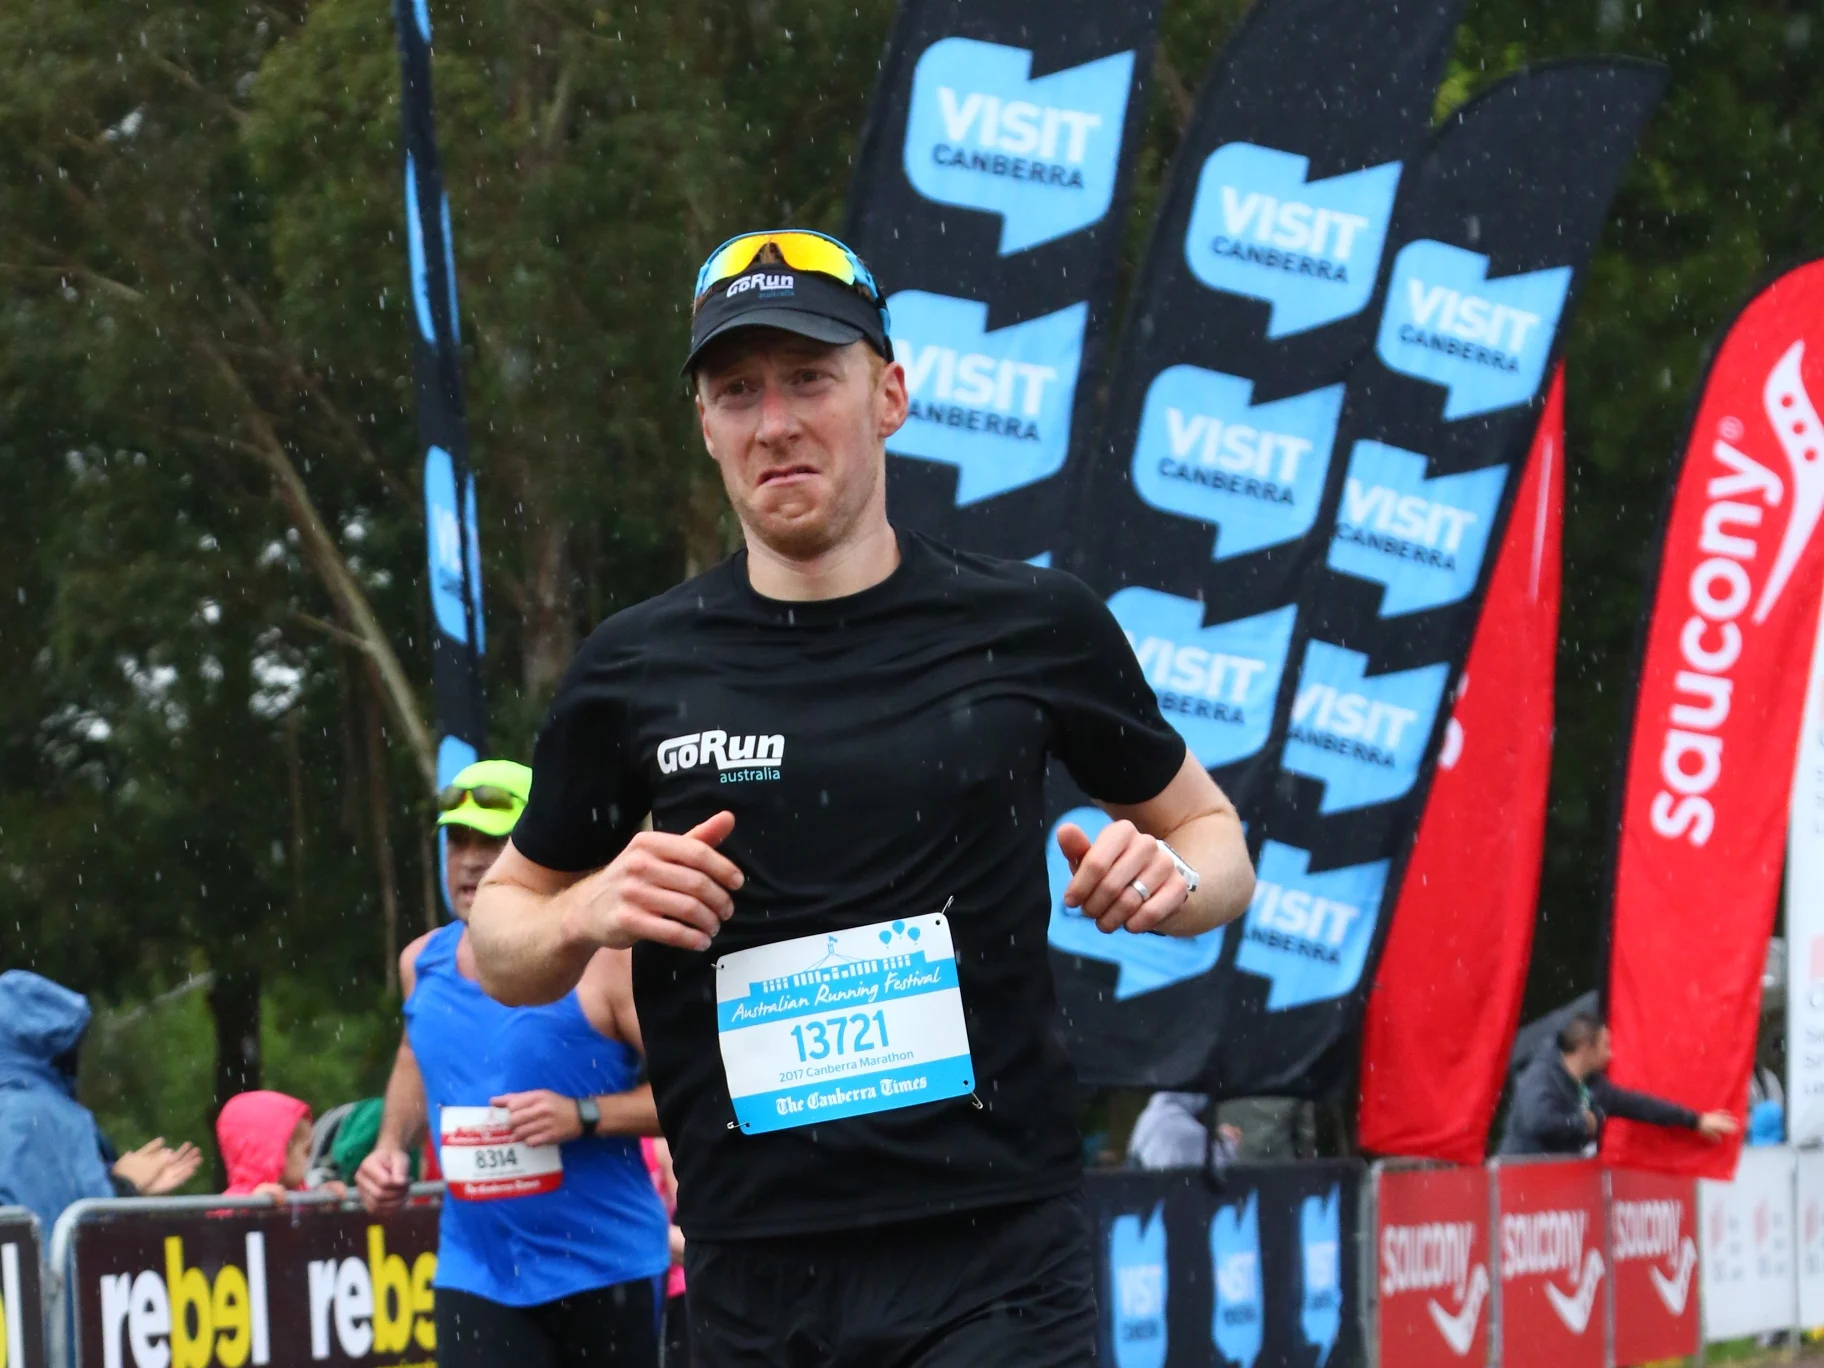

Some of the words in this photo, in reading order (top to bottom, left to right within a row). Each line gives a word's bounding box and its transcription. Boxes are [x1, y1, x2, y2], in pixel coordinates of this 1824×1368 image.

[936, 86, 1102, 162] VISIT
[931, 143, 1084, 189] CANBERRA
[1221, 185, 1369, 260] VISIT
[1211, 235, 1349, 283] CANBERRA
[726, 272, 794, 298] GoRun
[1407, 277, 1540, 353] VISIT
[1399, 323, 1519, 373] CANBERRA
[894, 339, 1057, 416] VISIT
[908, 399, 1040, 441] ANBERRA
[1166, 406, 1313, 482] VISIT
[1158, 457, 1295, 506] CANBERRA
[1346, 476, 1478, 553] VISIT
[1335, 522, 1456, 572] CANBERRA
[1160, 690, 1245, 725] BERRA
[657, 729, 786, 775] GoRun
[1287, 727, 1396, 770] ANBERRA
[719, 767, 781, 783] australia
[1246, 928, 1341, 965] NBERRA
[732, 993, 810, 1023] Australian
[815, 983, 879, 1006] Running
[884, 966, 942, 994] Festival
[790, 1009, 889, 1062] 13721
[778, 1069, 804, 1083] 2017
[806, 1061, 857, 1078] Canberra
[862, 1050, 914, 1068] Marathon
[776, 1097, 804, 1115] The
[806, 1084, 876, 1110] Canberra
[880, 1075, 927, 1096] Times
[308, 1225, 438, 1360] rebe
